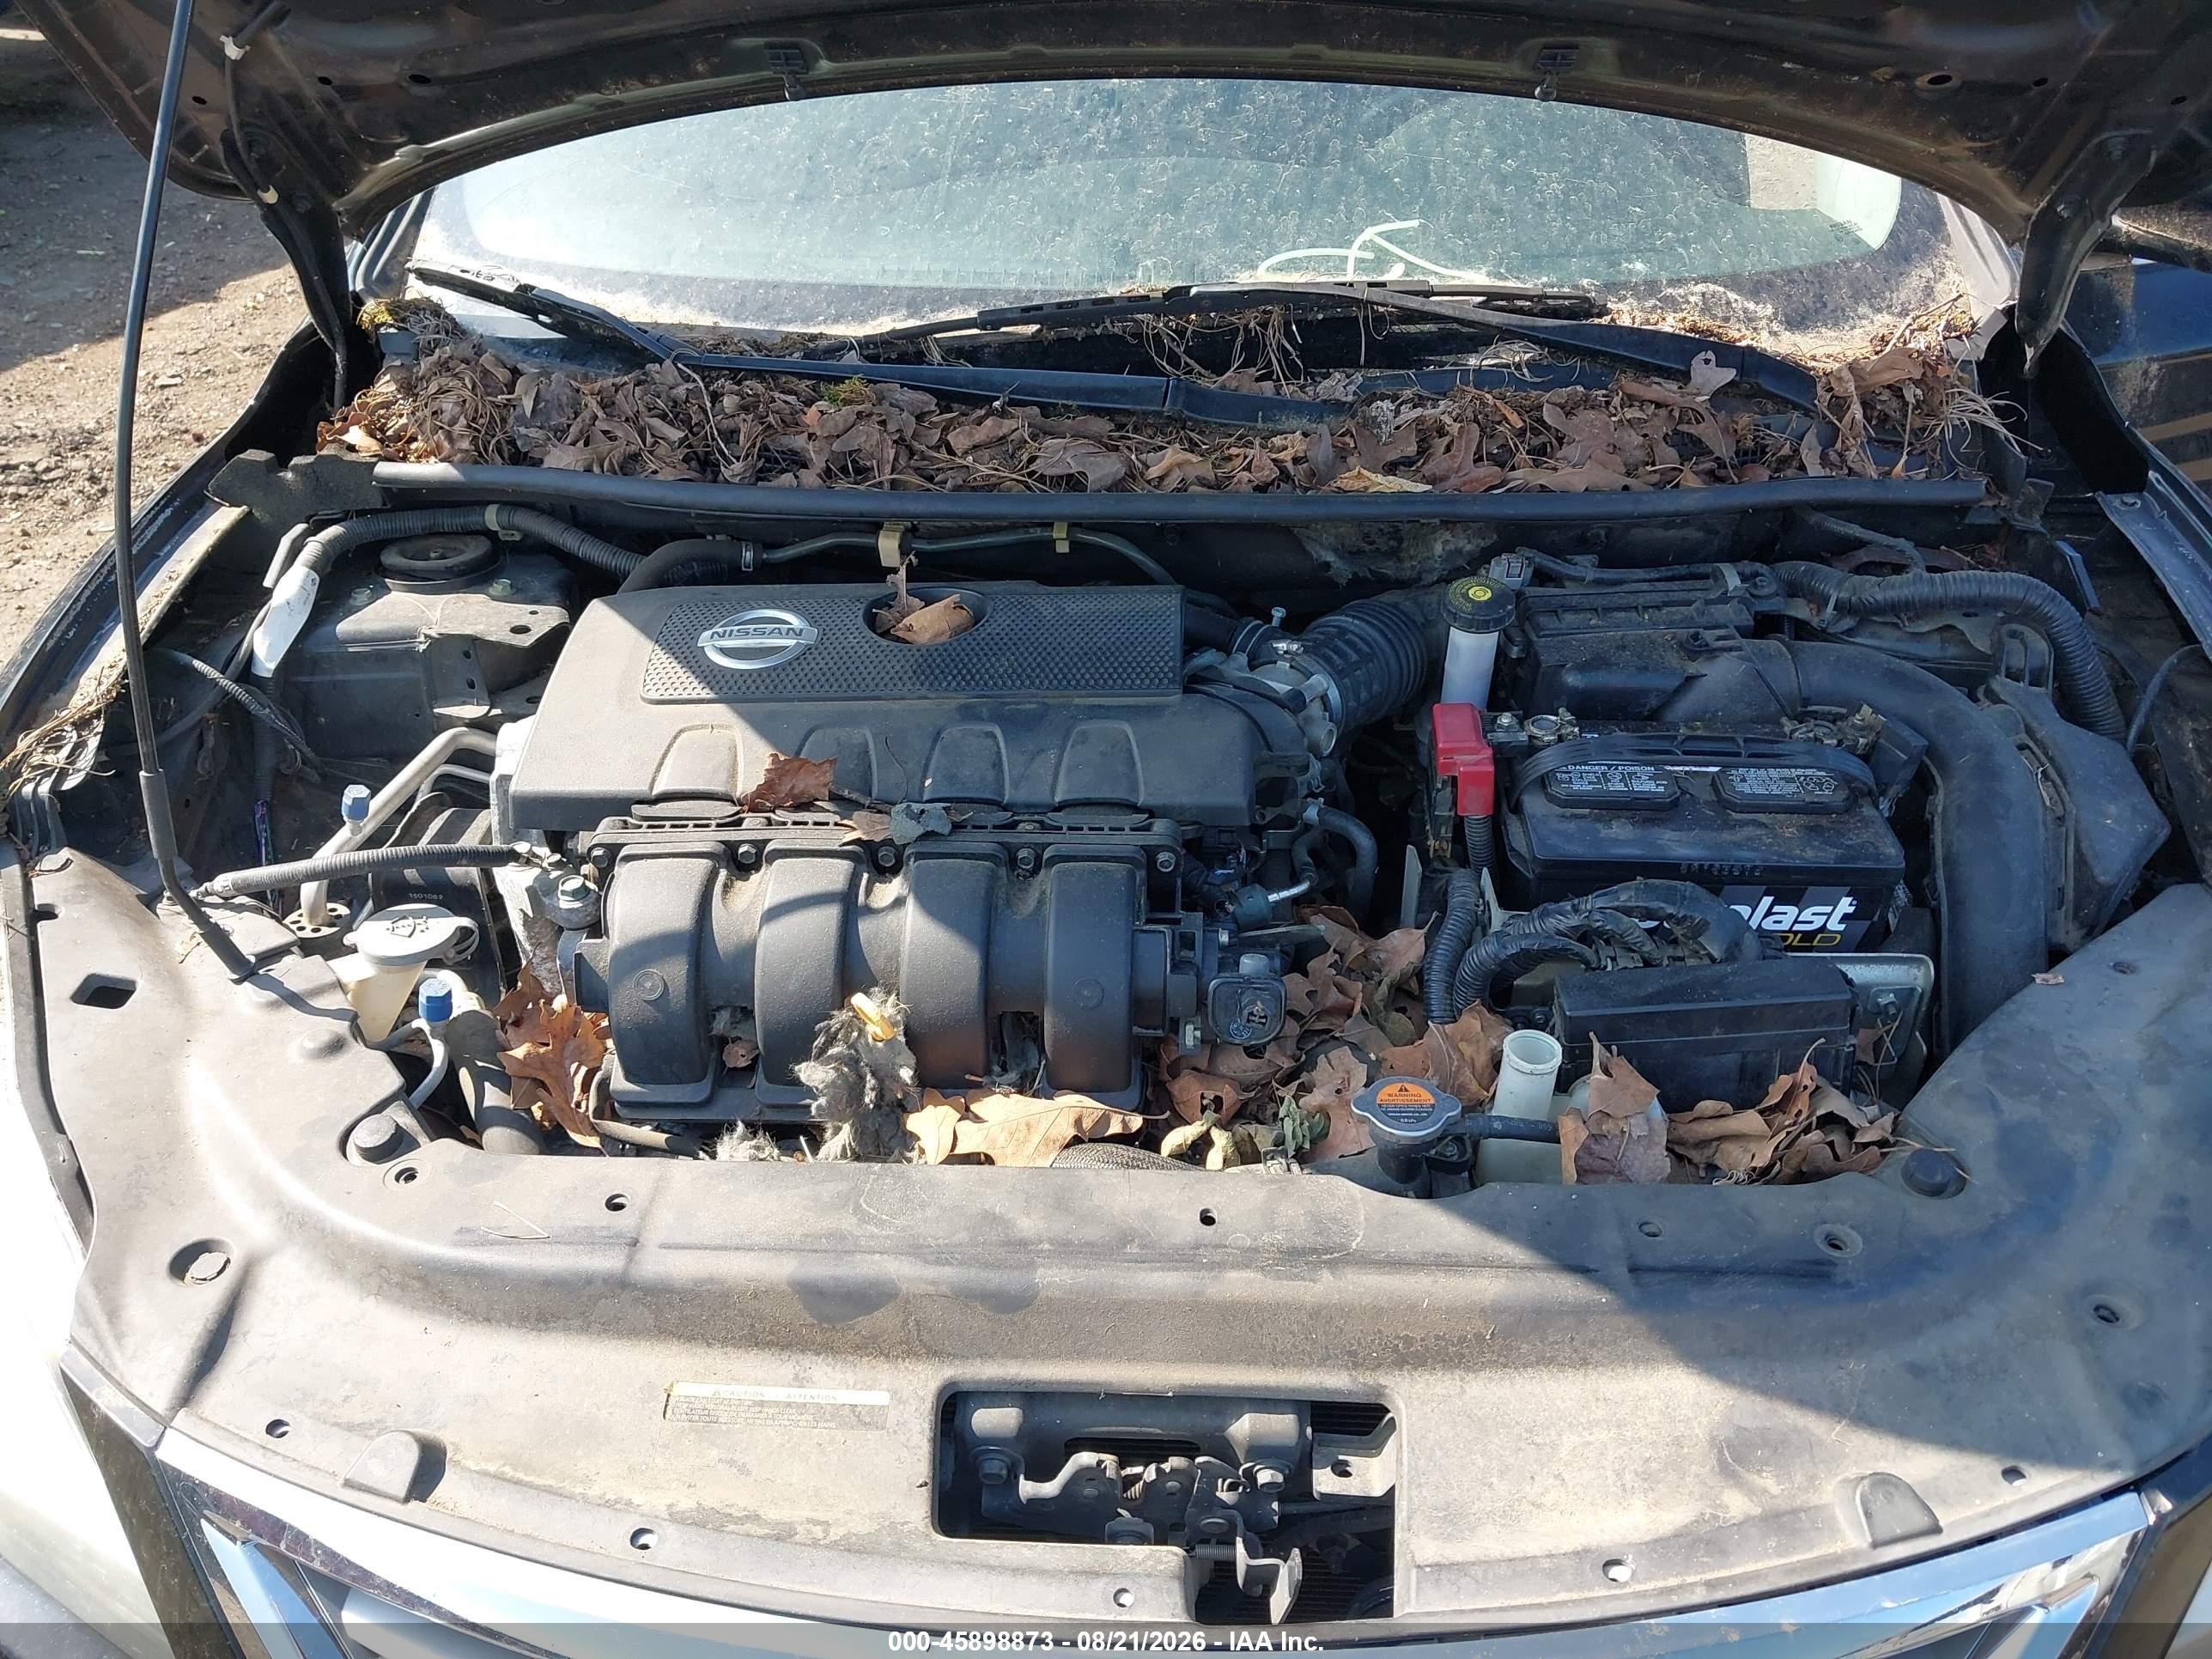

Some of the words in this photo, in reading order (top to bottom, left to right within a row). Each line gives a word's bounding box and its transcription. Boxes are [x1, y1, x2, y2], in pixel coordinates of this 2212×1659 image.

[709, 627, 805, 640] NISSAN
[1771, 933, 1841, 945] OLD
[786, 1393, 837, 1401] ATTENTION
